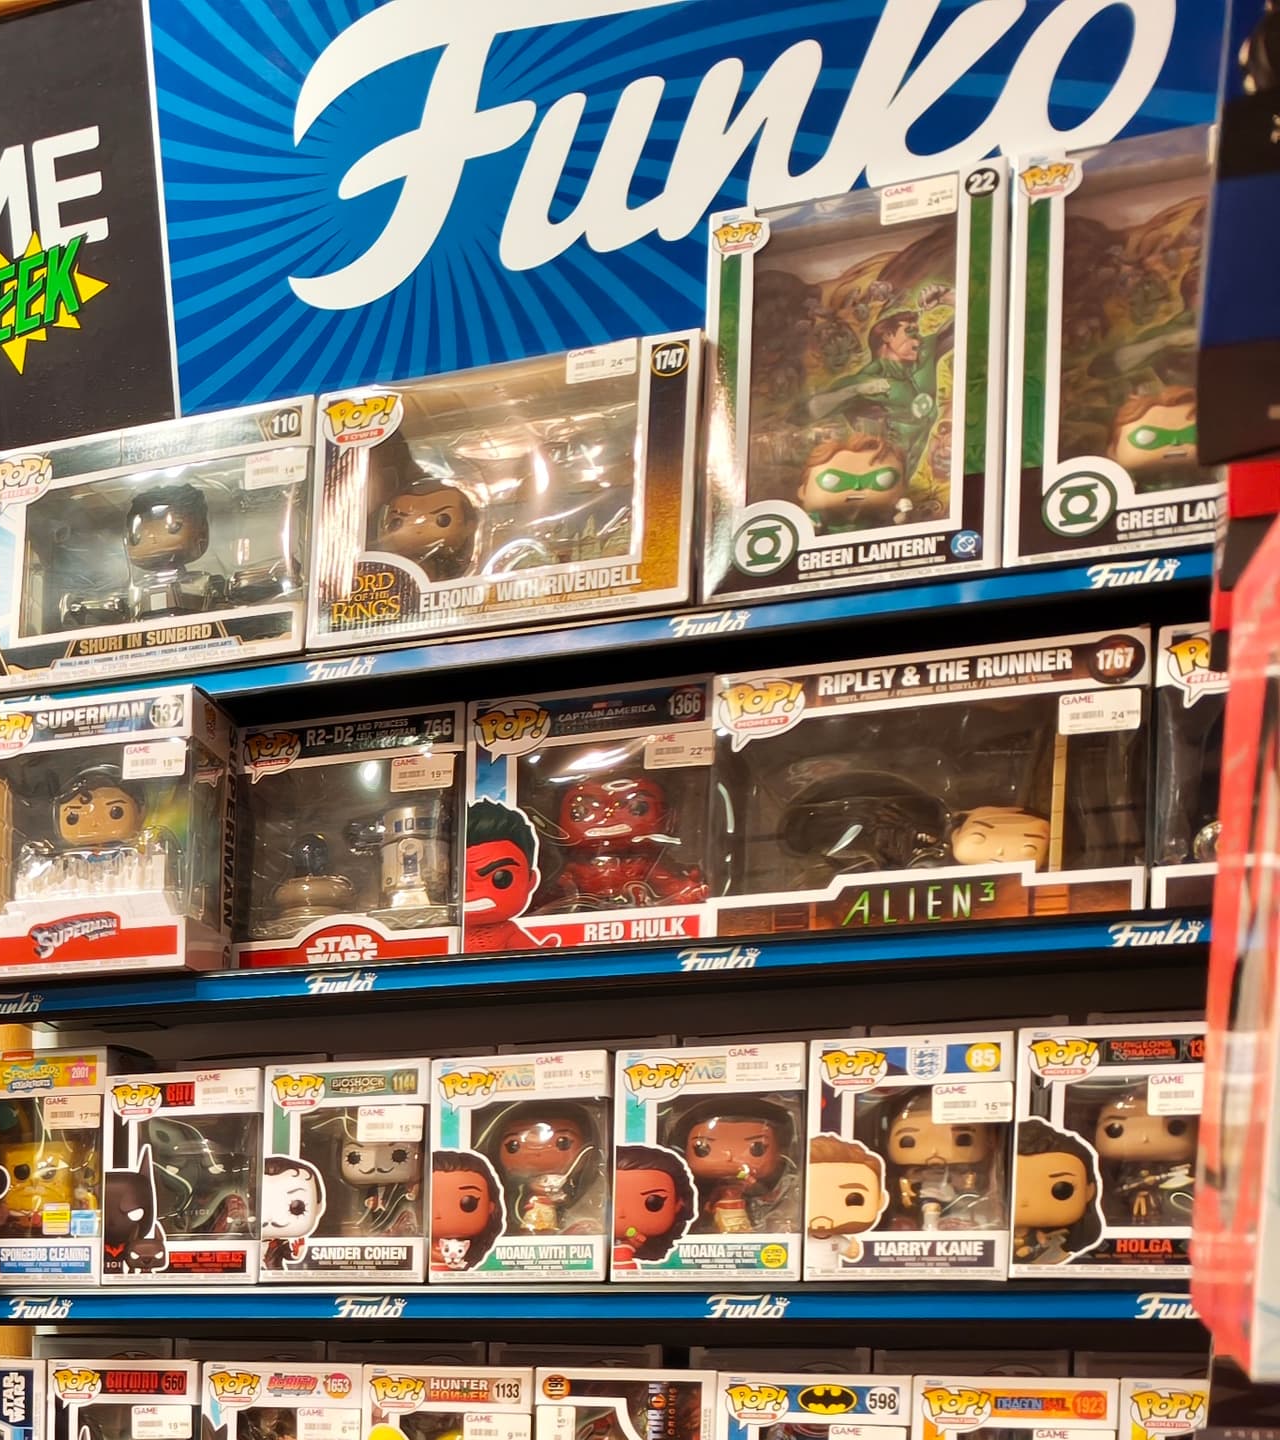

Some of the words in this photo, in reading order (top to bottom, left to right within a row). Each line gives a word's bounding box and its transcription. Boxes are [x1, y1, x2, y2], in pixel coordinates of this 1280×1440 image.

[287, 0, 1176, 311] Funko
[969, 171, 998, 193] 22
[654, 347, 686, 372] 1747
[323, 395, 399, 433] POP!
[343, 429, 379, 443] TOWN
[798, 546, 855, 571] GREEN
[856, 539, 939, 565] LANTERN
[1086, 559, 1177, 590] Funko
[419, 584, 483, 613] ELROND
[497, 577, 539, 599] WITH
[545, 563, 642, 594] RIVENDELL
[77, 635, 123, 656] SHURI
[127, 632, 141, 649] IN
[146, 623, 213, 647] SUNBIRD
[1094, 647, 1134, 671] 1767
[817, 669, 897, 697] RIPLEY
[901, 666, 920, 689] &
[924, 659, 970, 684] THE
[976, 649, 1073, 679] RUNNER
[34, 701, 144, 732] SUPERMAN
[305, 723, 355, 749] R2-D2
[582, 920, 627, 943] RED
[632, 916, 686, 939] HULK
[970, 1047, 996, 1067] 85
[310, 1246, 358, 1262] SANDER
[360, 1245, 407, 1261] COHEN
[494, 1248, 533, 1261] MOANA
[537, 1247, 565, 1260] WITH
[569, 1246, 593, 1260] PUA
[873, 1242, 926, 1257] HARRY
[930, 1240, 985, 1256] KANE
[1115, 1237, 1173, 1255] HOLGA
[429, 1377, 488, 1391] HUNTER
[867, 1391, 898, 1411] 598
